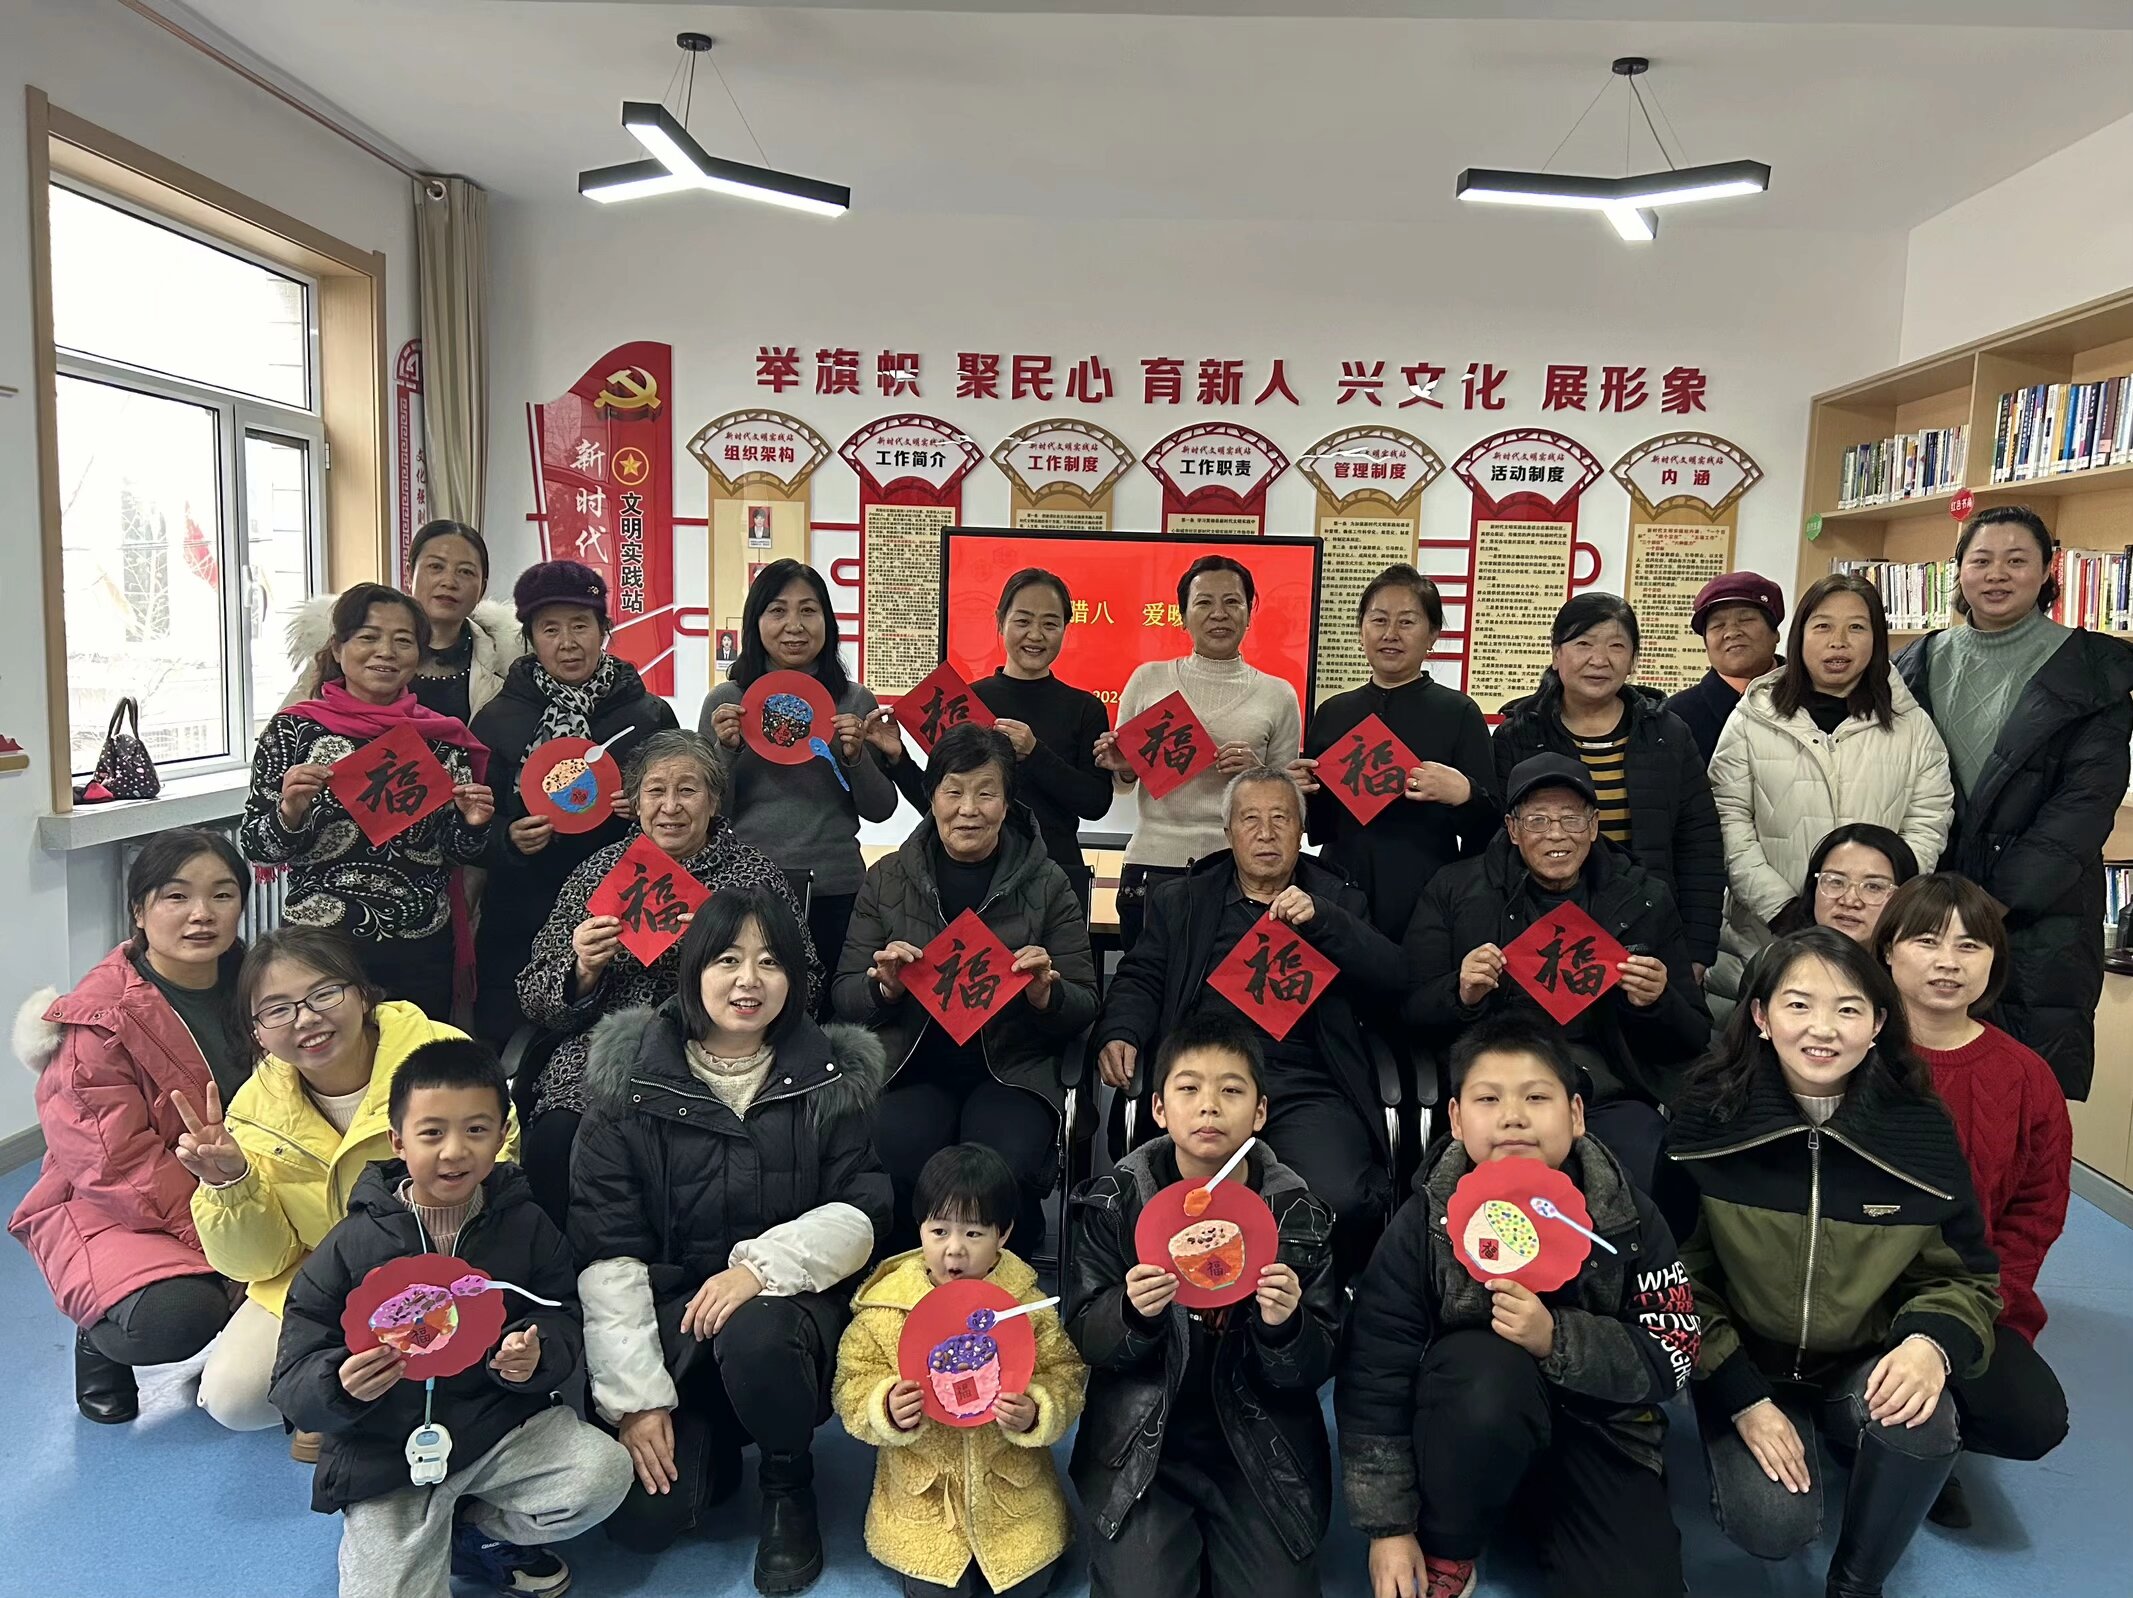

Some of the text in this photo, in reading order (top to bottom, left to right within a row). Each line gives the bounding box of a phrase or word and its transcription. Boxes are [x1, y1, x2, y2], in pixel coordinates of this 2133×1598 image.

[756, 346, 1707, 414] 举旗帜 聚民心 育新人 兴文化 展形象
[724, 444, 795, 463] 组织架构
[876, 450, 946, 468] 工作简介
[1028, 455, 1099, 472] 工作制度
[1180, 459, 1252, 477] 工作职责
[1334, 462, 1407, 479] 管理制度
[1491, 465, 1565, 483] 活动制度
[620, 491, 644, 613] 文明实践站
[1092, 690, 1121, 704] 202
[1138, 709, 1197, 775] 福
[1339, 734, 1406, 797] 福
[356, 747, 428, 817] 福
[617, 862, 690, 935] 福
[932, 938, 1001, 1013] 福
[1243, 932, 1314, 1006] 福
[1534, 922, 1607, 998] 福
[1637, 1261, 1689, 1293] WHE
